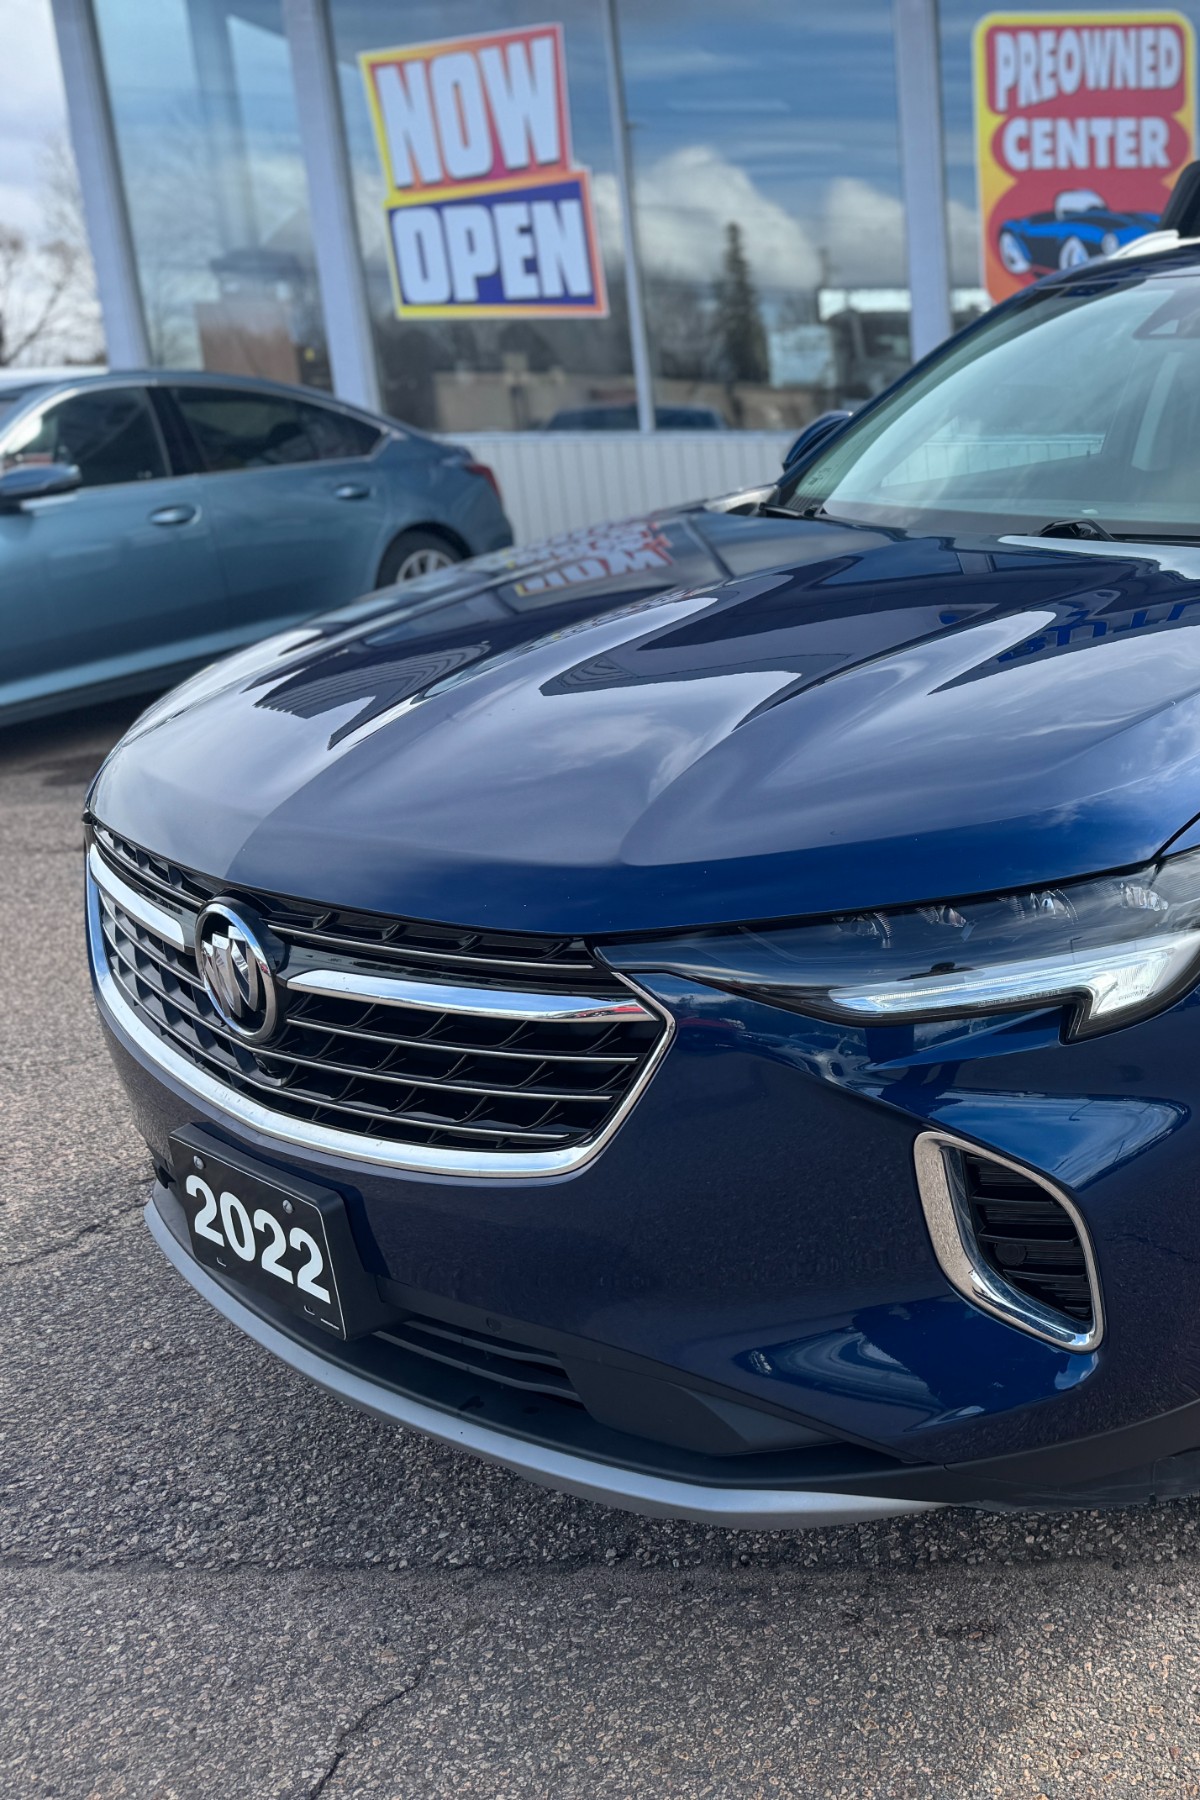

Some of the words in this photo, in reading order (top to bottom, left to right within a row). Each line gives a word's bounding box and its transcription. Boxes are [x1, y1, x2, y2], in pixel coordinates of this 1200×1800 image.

[373, 35, 560, 190] NOW
[994, 26, 1182, 113] PREOWNED
[1002, 116, 1171, 172] CENTER
[390, 199, 593, 304] OPEN
[185, 1174, 332, 1305] 2022
